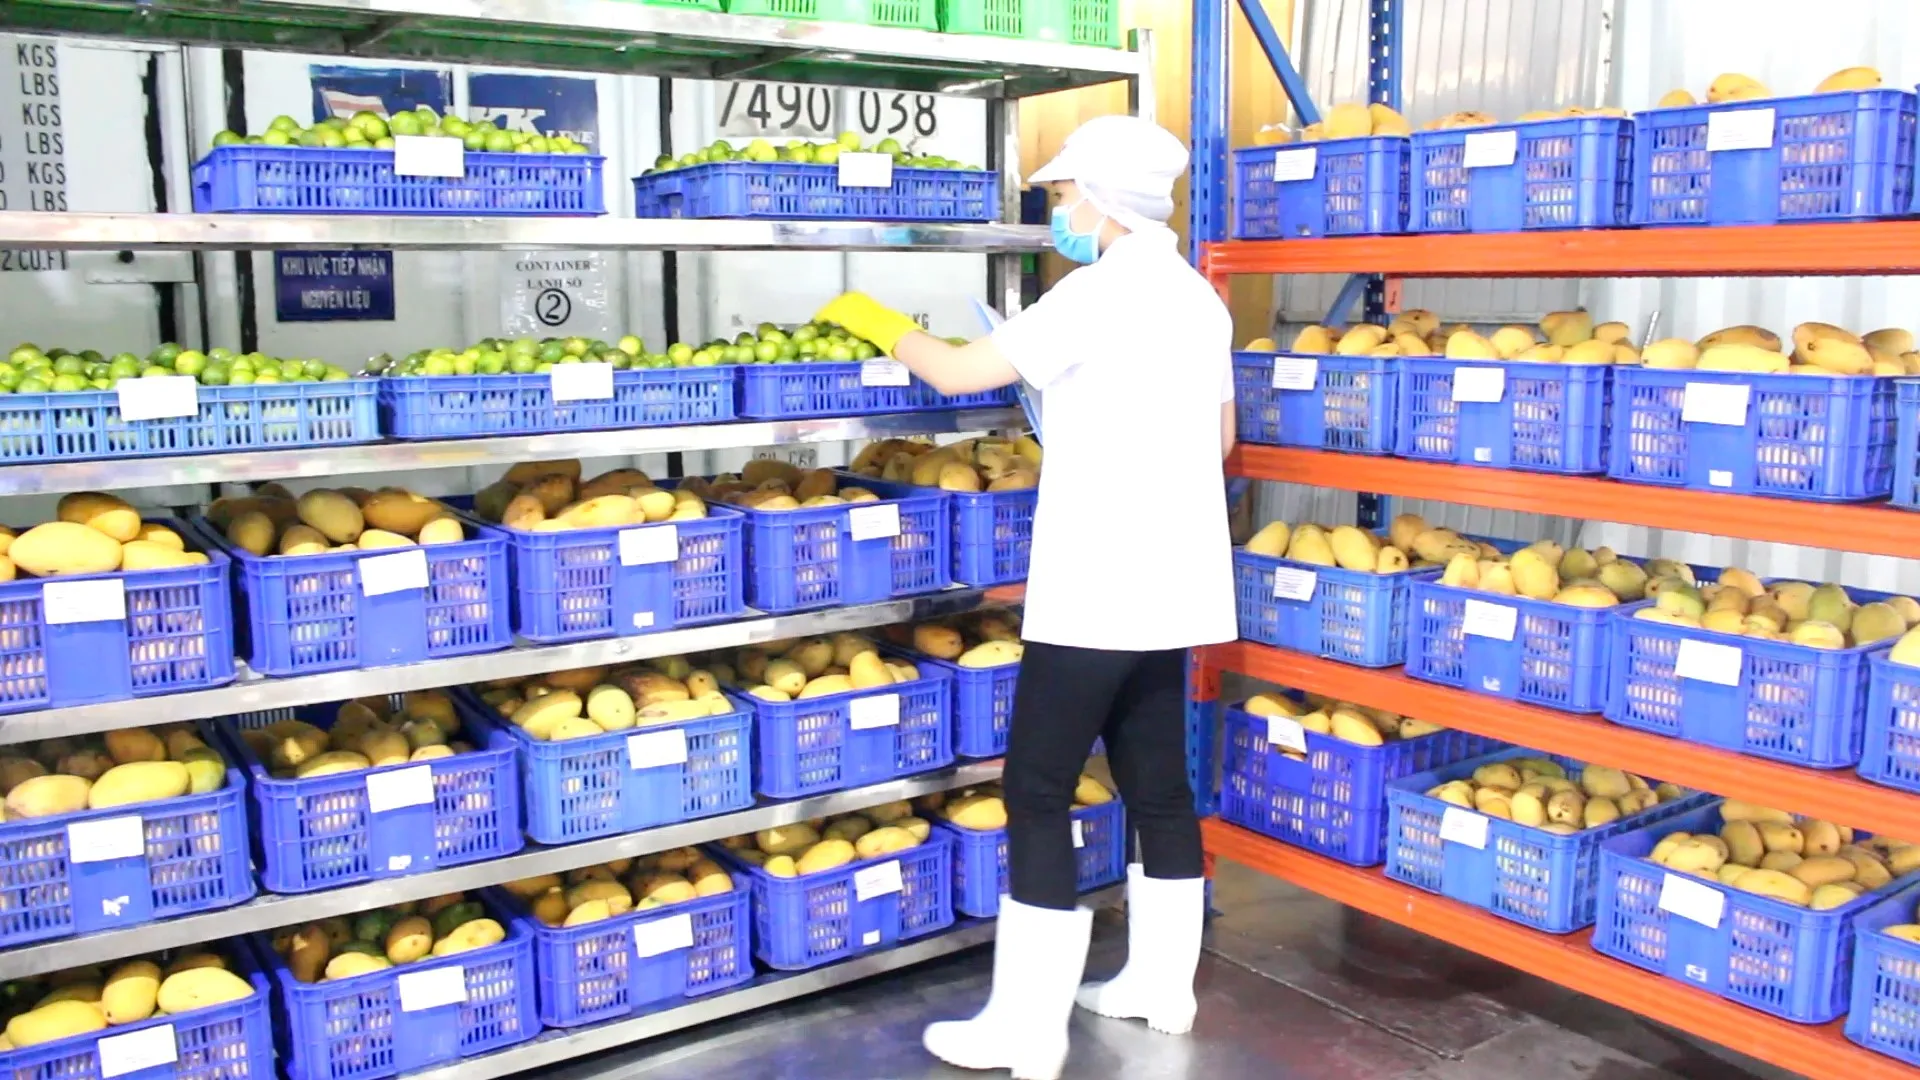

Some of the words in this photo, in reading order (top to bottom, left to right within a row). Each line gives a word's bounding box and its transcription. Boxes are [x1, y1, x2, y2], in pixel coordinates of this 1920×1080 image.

[17, 43, 57, 68] KGS
[20, 70, 59, 96] LBS
[22, 102, 62, 127] KGS
[25, 131, 64, 155] LBS
[27, 161, 67, 185] KGS
[30, 189, 68, 211] LBS
[281, 256, 305, 276] KHU
[330, 250, 356, 276] TIẾP
[357, 252, 387, 280] NHẬN
[515, 260, 591, 272] CONTAINER
